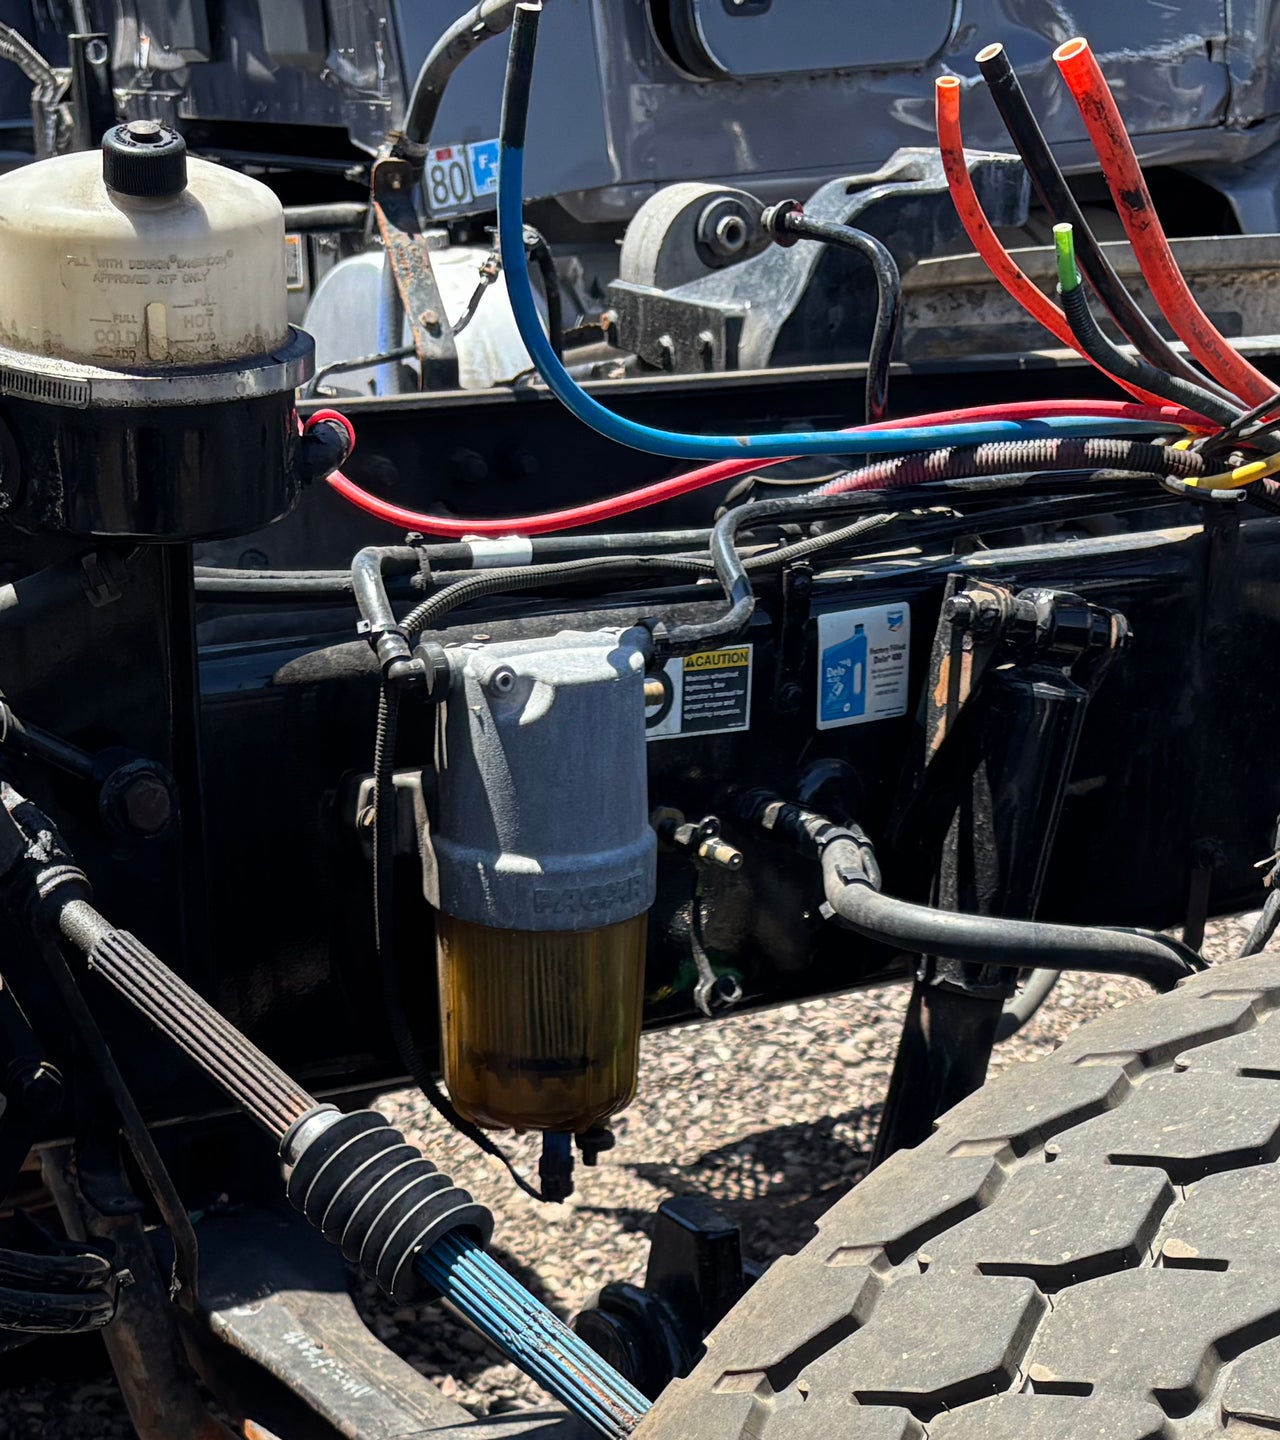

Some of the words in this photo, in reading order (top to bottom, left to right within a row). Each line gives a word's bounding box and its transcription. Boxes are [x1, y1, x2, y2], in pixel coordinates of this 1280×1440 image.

[97, 258, 123, 270] WITH
[93, 273, 151, 285] APPROVED
[182, 269, 210, 284] ONLY
[112, 314, 138, 324] FULL
[183, 314, 213, 329] HOT
[94, 329, 138, 345] COLD
[695, 651, 749, 667] CAUTION
[826, 666, 846, 678] Delo
